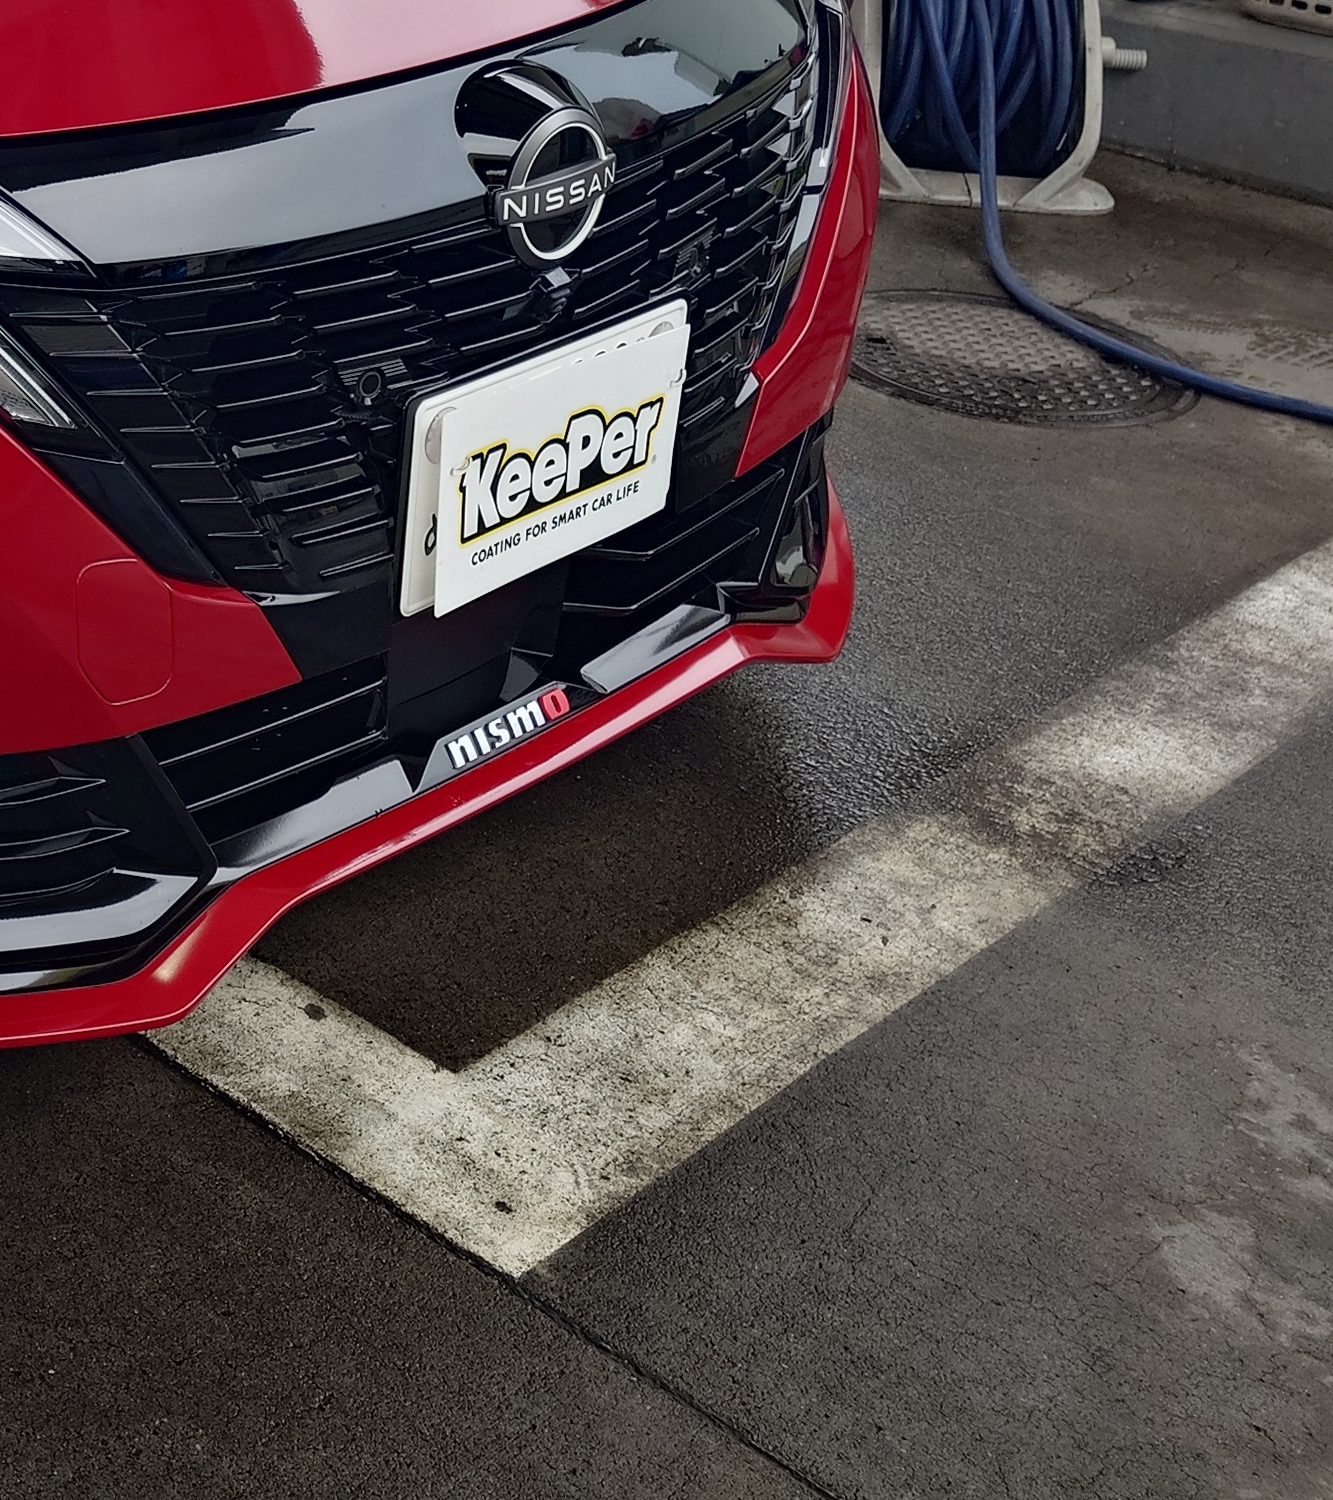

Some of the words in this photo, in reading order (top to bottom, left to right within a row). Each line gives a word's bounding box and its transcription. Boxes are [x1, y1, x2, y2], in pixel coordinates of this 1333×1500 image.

[503, 161, 615, 221] NISSAN
[461, 398, 664, 542] KeePer
[471, 534, 521, 566] COATING
[525, 520, 547, 542] FOR
[551, 504, 589, 530] SMART
[591, 493, 614, 512] CAR
[616, 480, 640, 501] LIFE
[445, 688, 570, 770] nismo
